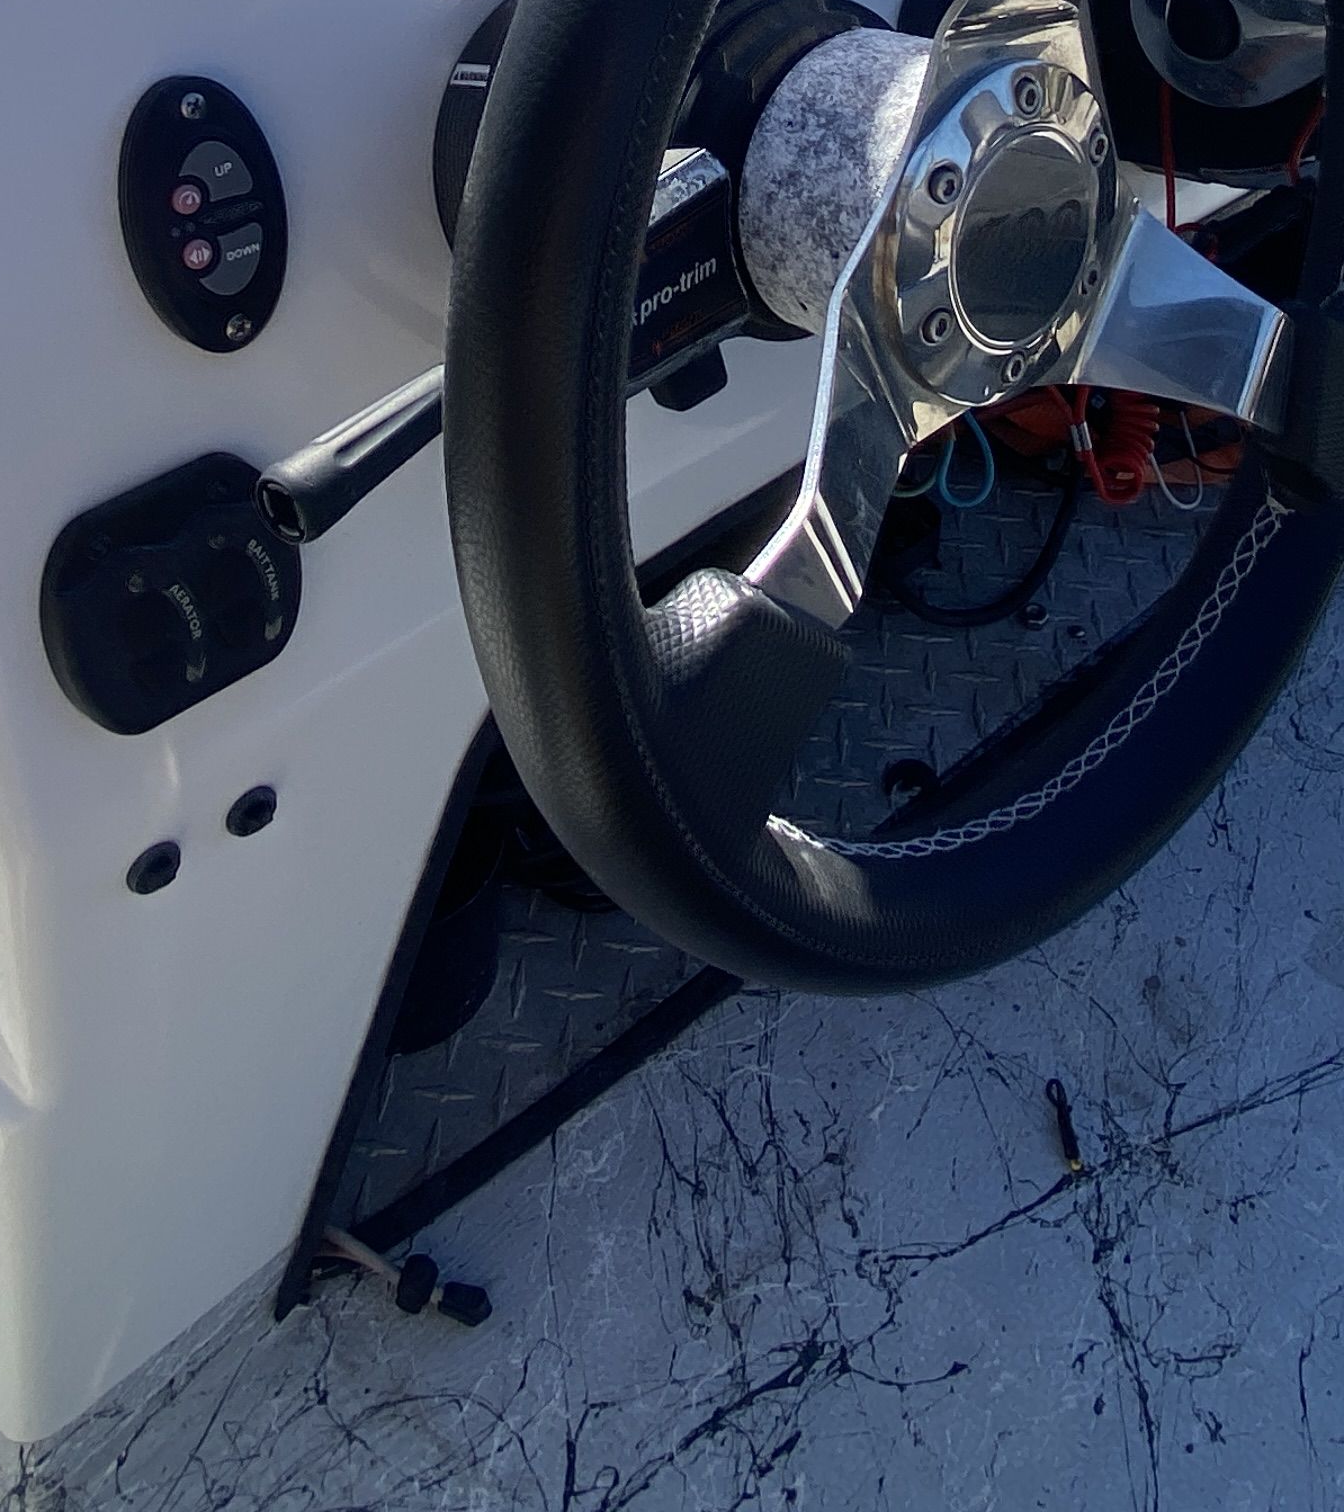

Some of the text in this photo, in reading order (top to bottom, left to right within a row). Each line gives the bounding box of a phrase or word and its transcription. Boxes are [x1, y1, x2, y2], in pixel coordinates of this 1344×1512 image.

[214, 162, 232, 177] UP
[226, 242, 260, 261] DOWN
[640, 257, 717, 326] pro-trim
[168, 584, 203, 640] AERATOR
